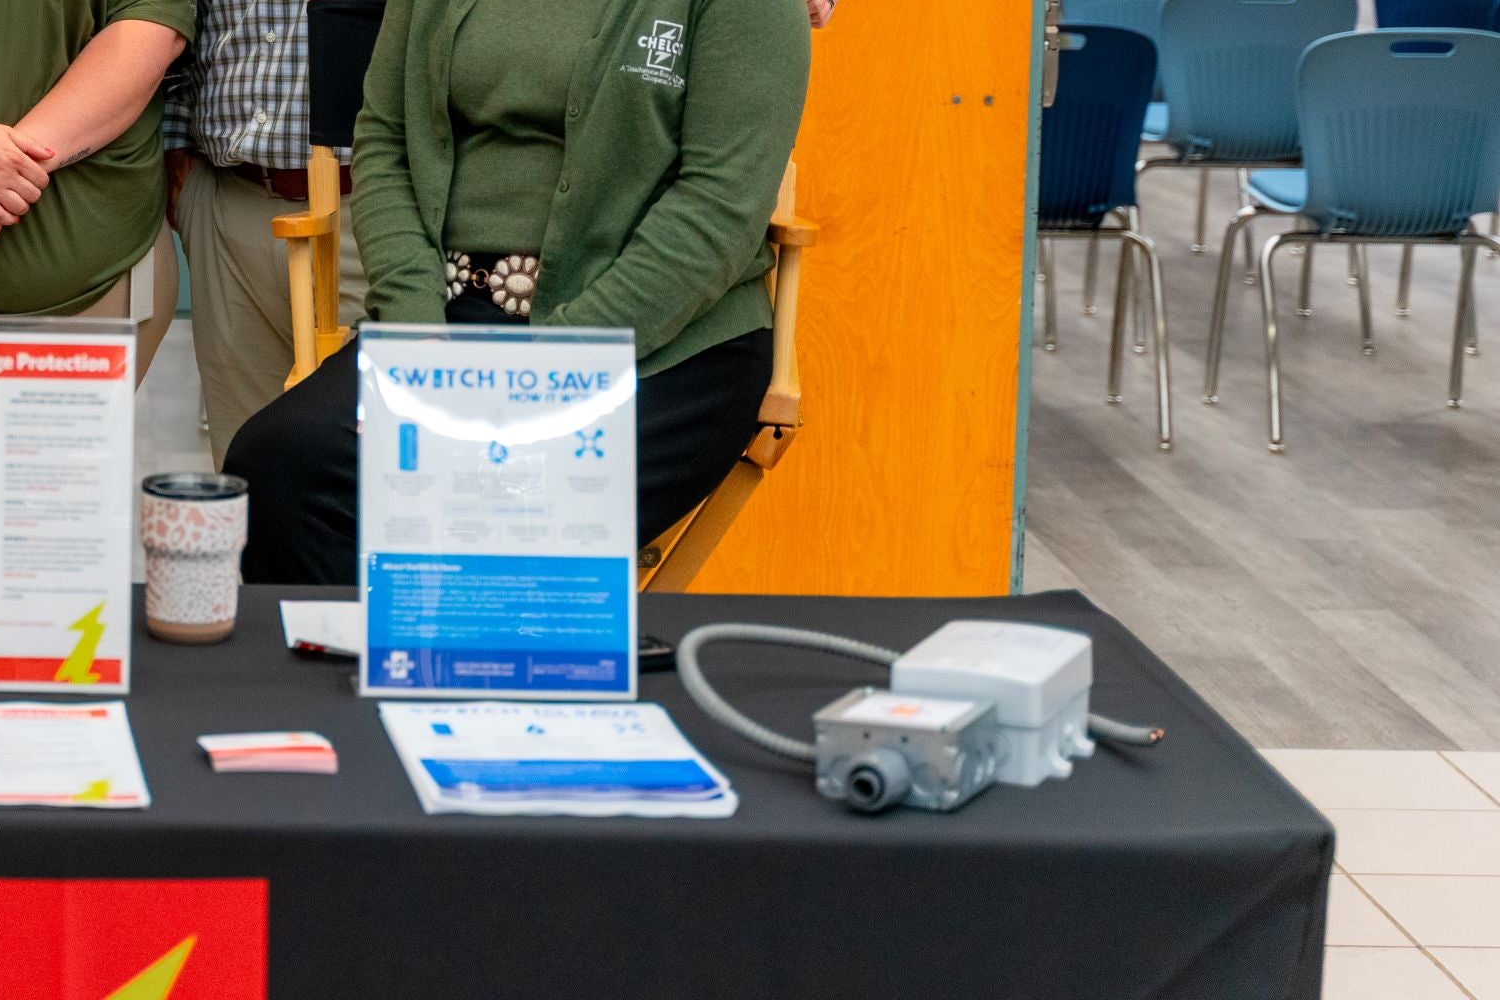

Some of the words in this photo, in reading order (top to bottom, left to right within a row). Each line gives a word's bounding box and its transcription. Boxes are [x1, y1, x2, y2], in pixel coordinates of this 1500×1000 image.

[15, 351, 111, 373] Protection
[506, 369, 538, 390] TO
[547, 371, 610, 392] SAVE
